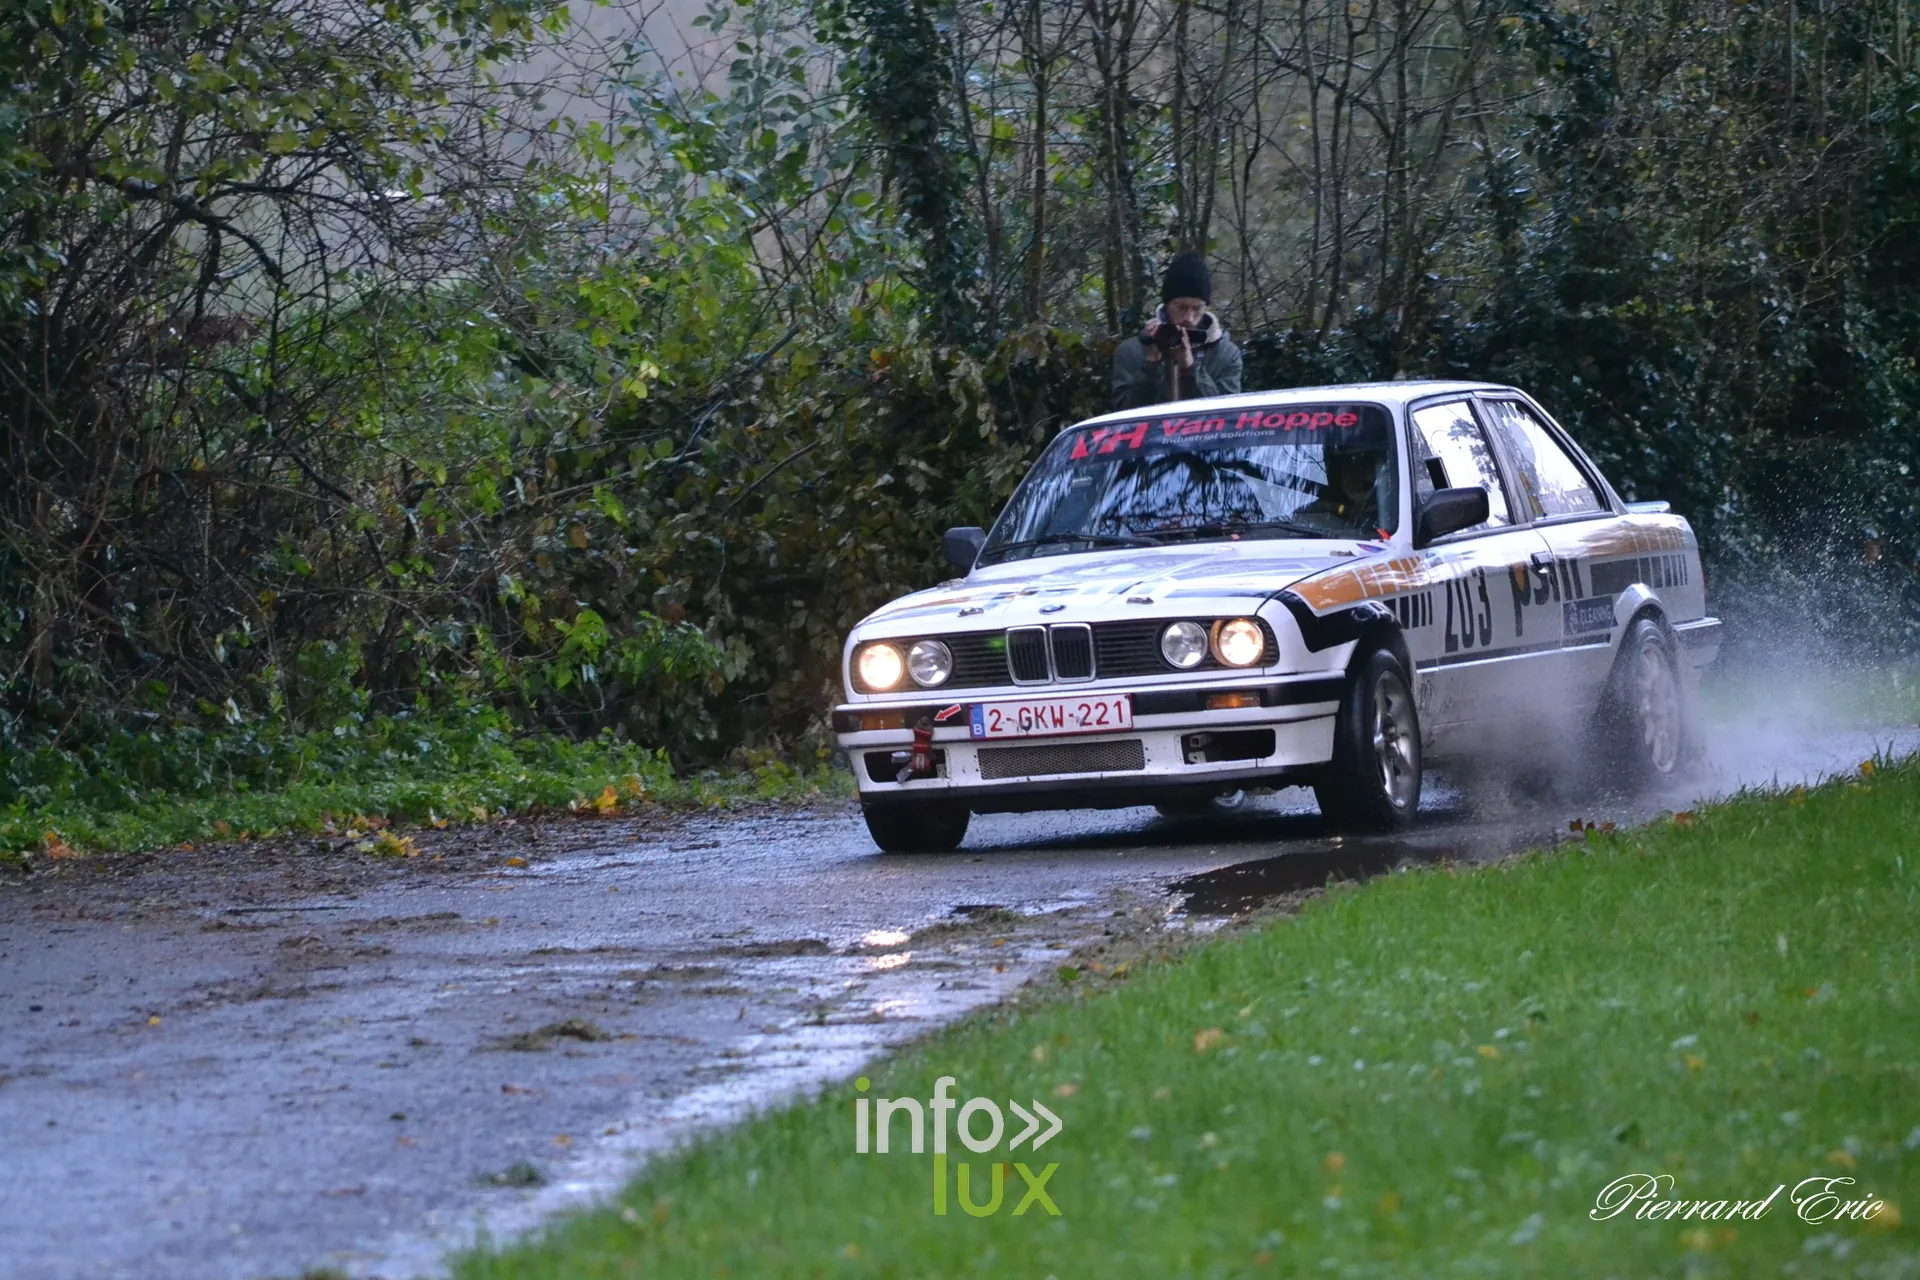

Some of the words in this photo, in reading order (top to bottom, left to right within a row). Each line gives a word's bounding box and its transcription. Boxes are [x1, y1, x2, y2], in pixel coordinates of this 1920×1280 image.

[1161, 416, 1225, 438] Van
[1235, 410, 1358, 431] Hoppe
[1220, 429, 1276, 440] solutions
[1444, 567, 1493, 653] 203
[973, 723, 983, 736] B
[988, 700, 1125, 733] 2-GKW-221
